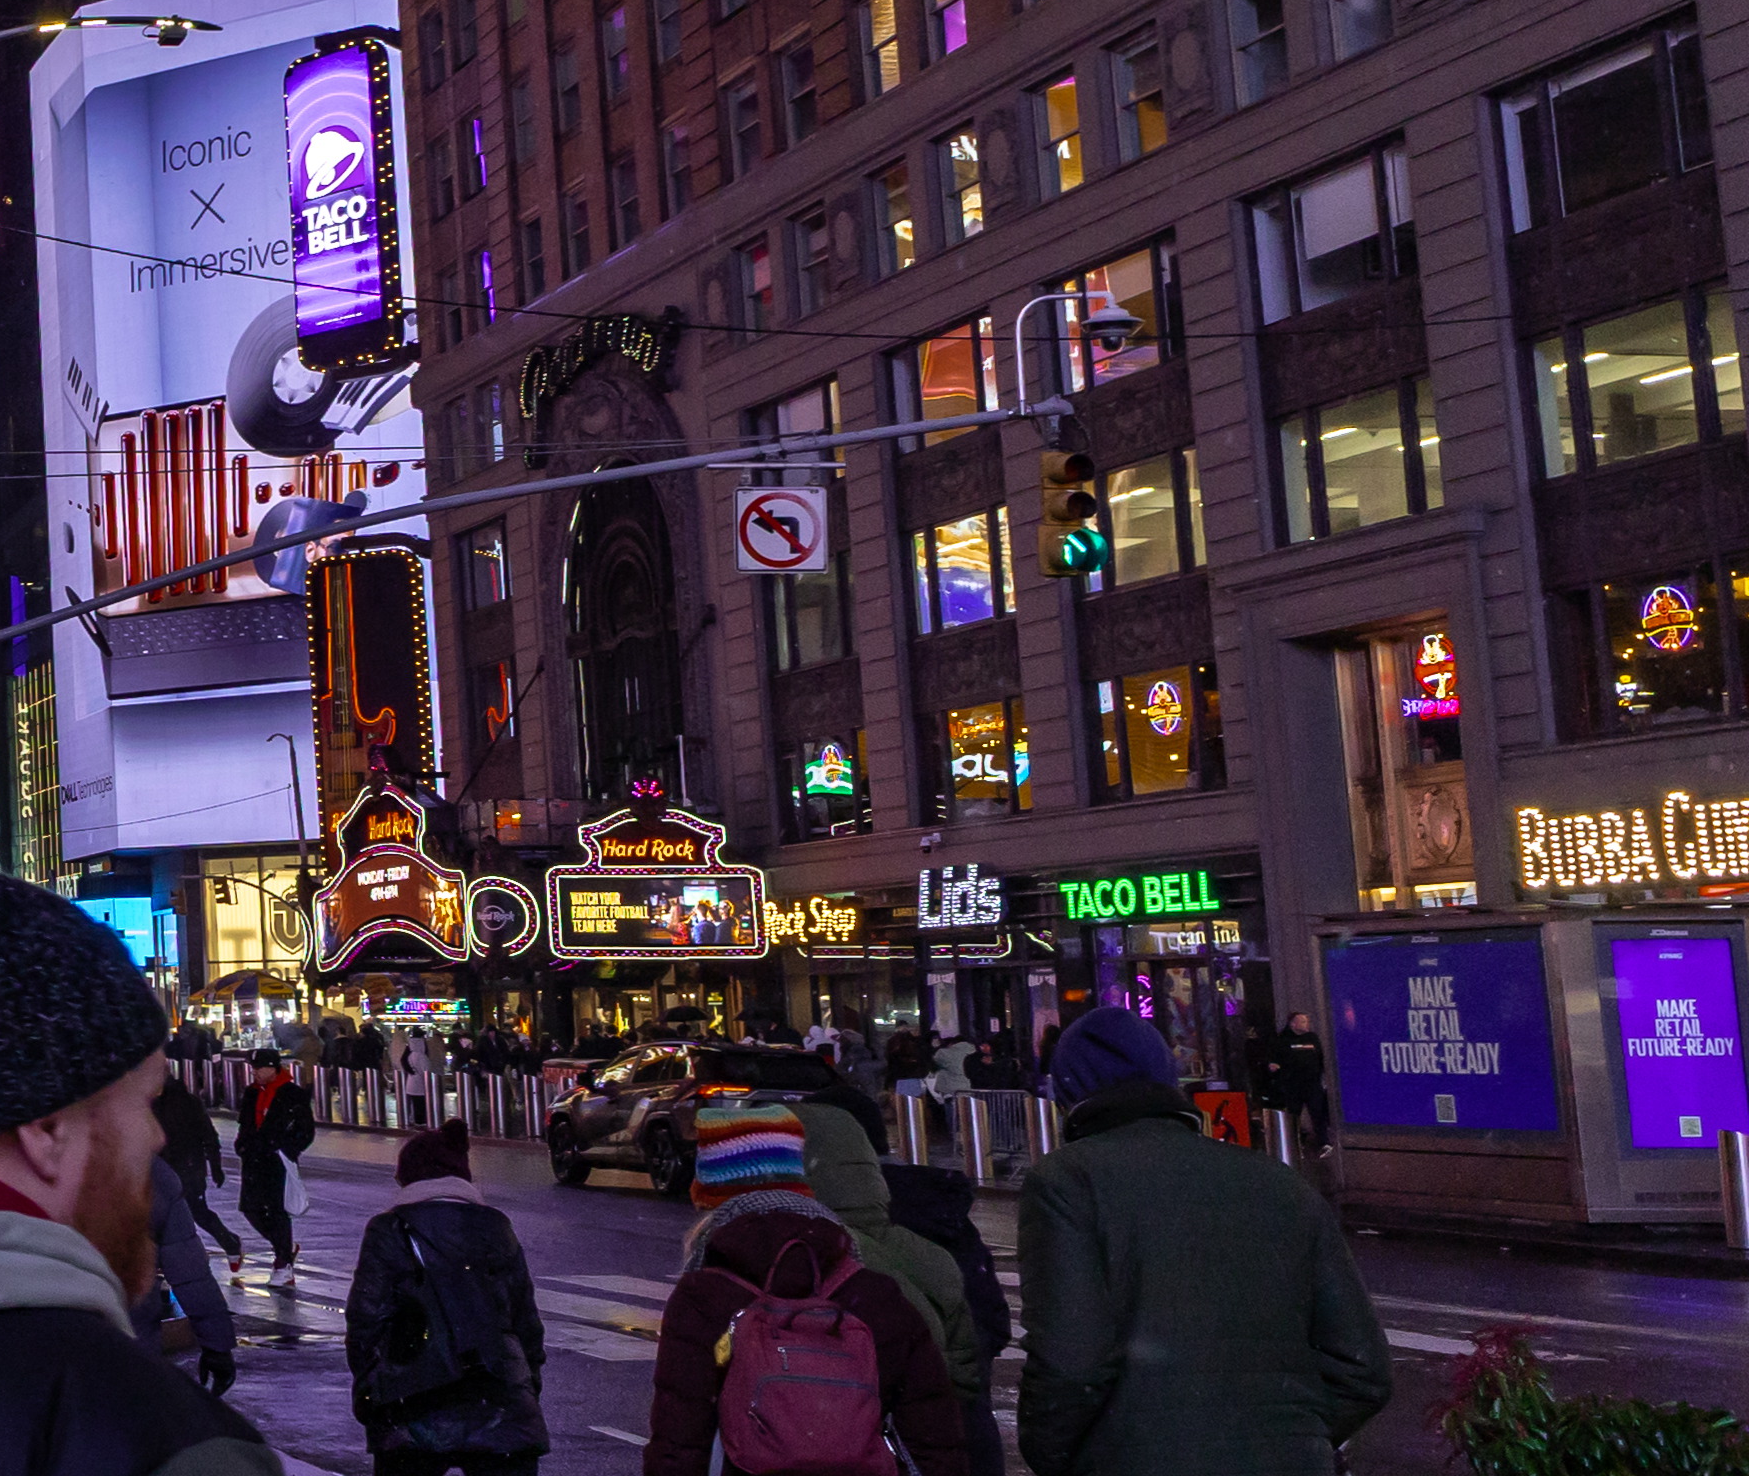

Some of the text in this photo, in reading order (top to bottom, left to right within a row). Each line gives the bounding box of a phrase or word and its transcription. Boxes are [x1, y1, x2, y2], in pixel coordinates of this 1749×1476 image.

[162, 126, 251, 173] Iconic
[302, 195, 368, 232] TACO
[307, 220, 370, 255] BELL
[130, 238, 289, 294] Immersive
[368, 812, 415, 842] Hard Rock
[602, 839, 695, 861] Hard Rock
[1515, 807, 1660, 888] BUBBA
[570, 891, 622, 906] WATCH YOUR
[918, 864, 1002, 928] Lids
[1060, 871, 1220, 920] TACO BELL
[571, 905, 650, 920] FAVORITE FOOTBALL
[572, 919, 596, 933] TEAM
[764, 897, 857, 944] Rock Shop
[1408, 977, 1456, 1009] MAKE
[1656, 999, 1698, 1018] MAKE
[1408, 1010, 1464, 1041] RETAIL
[1655, 1019, 1704, 1037] RETAIL
[1380, 1042, 1501, 1075] FUTURE-READY
[1627, 1038, 1734, 1057] FUTURE-READY
